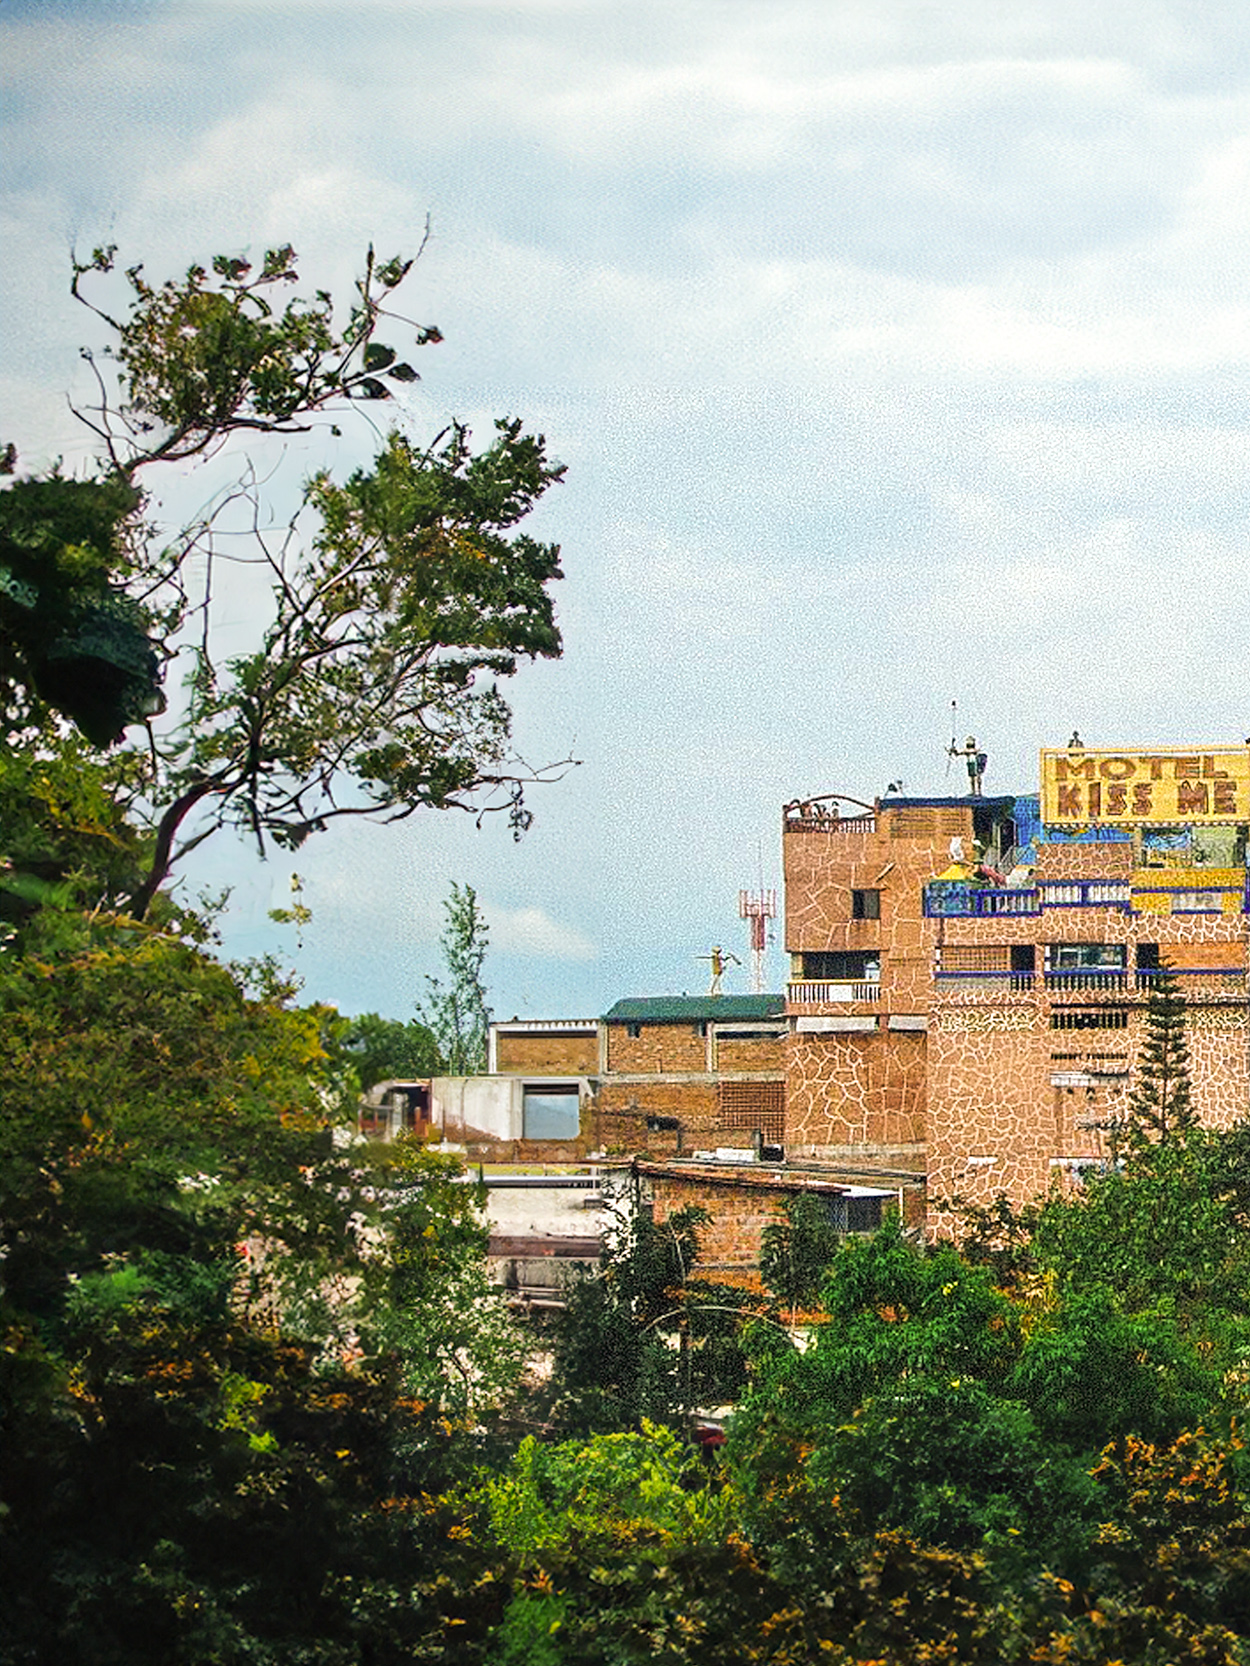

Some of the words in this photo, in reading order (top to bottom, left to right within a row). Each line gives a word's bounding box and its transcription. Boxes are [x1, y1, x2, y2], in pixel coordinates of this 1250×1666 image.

[1055, 756, 1228, 780] MOTEL
[1058, 780, 1152, 817] KISS
[1177, 780, 1237, 815] ME
